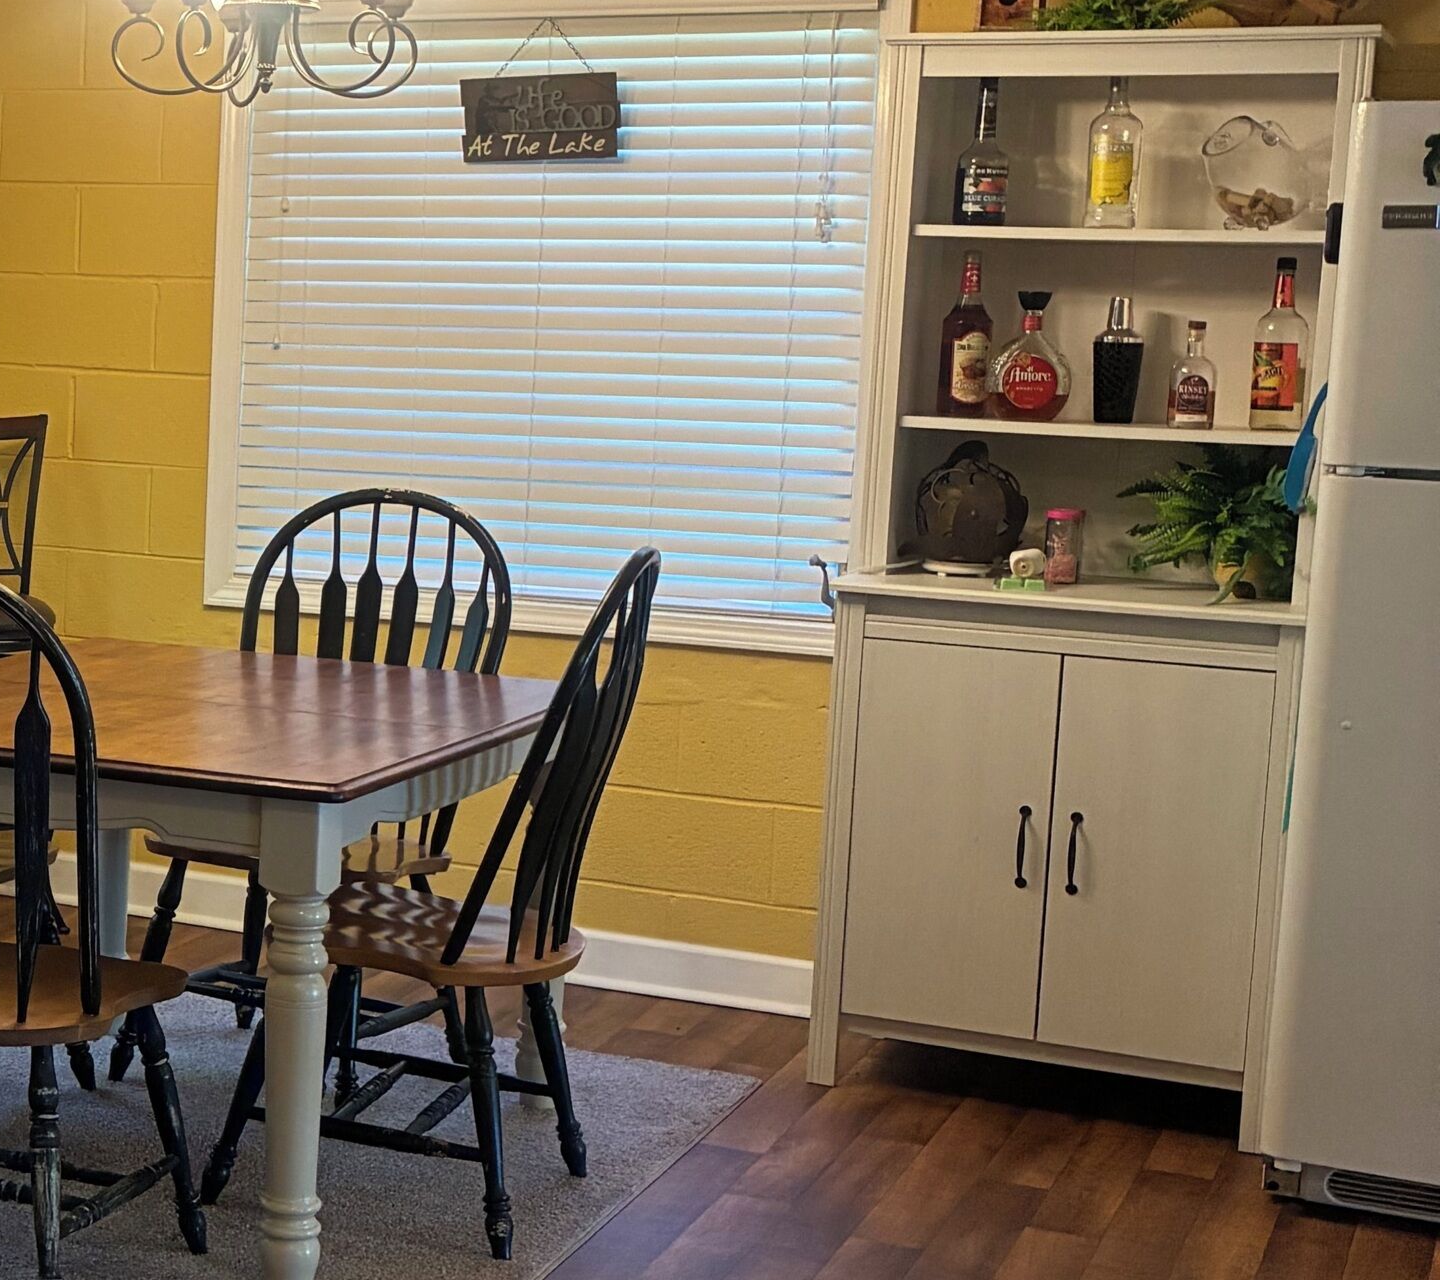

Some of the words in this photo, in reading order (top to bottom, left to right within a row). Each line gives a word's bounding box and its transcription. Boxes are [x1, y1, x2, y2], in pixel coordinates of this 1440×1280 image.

[542, 104, 616, 131] GOOD
[467, 135, 492, 157] At
[502, 133, 541, 157] The
